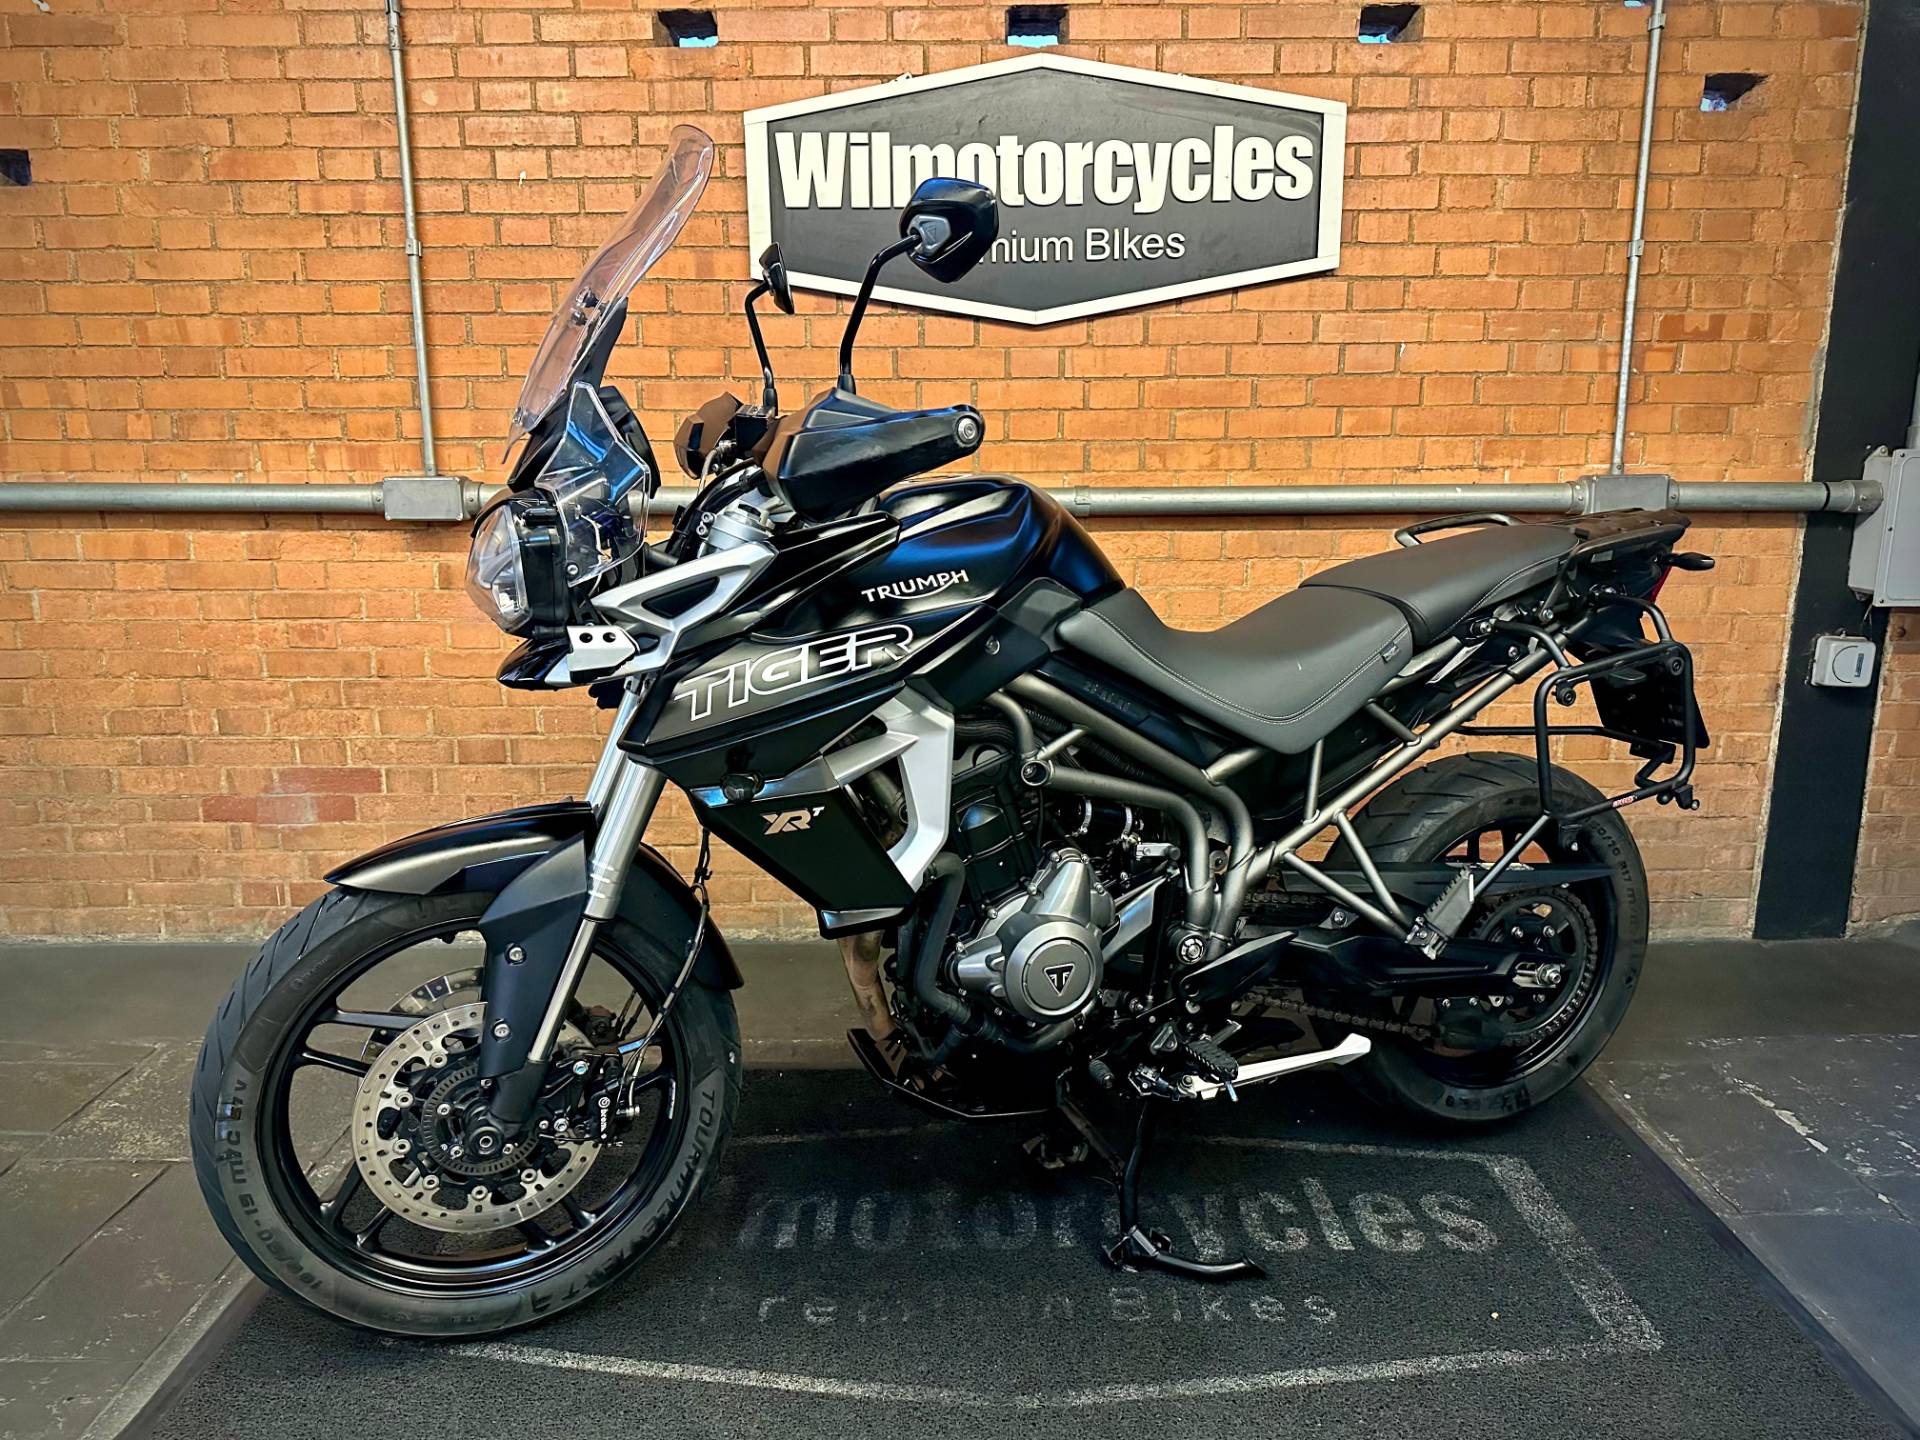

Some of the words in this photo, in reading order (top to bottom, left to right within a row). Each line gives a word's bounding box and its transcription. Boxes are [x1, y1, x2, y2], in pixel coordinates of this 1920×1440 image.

[775, 126, 1313, 213] Wilmotorcycles
[978, 229, 1074, 264] mium
[861, 569, 969, 602] TRIUMPH
[673, 624, 914, 722] TIGER
